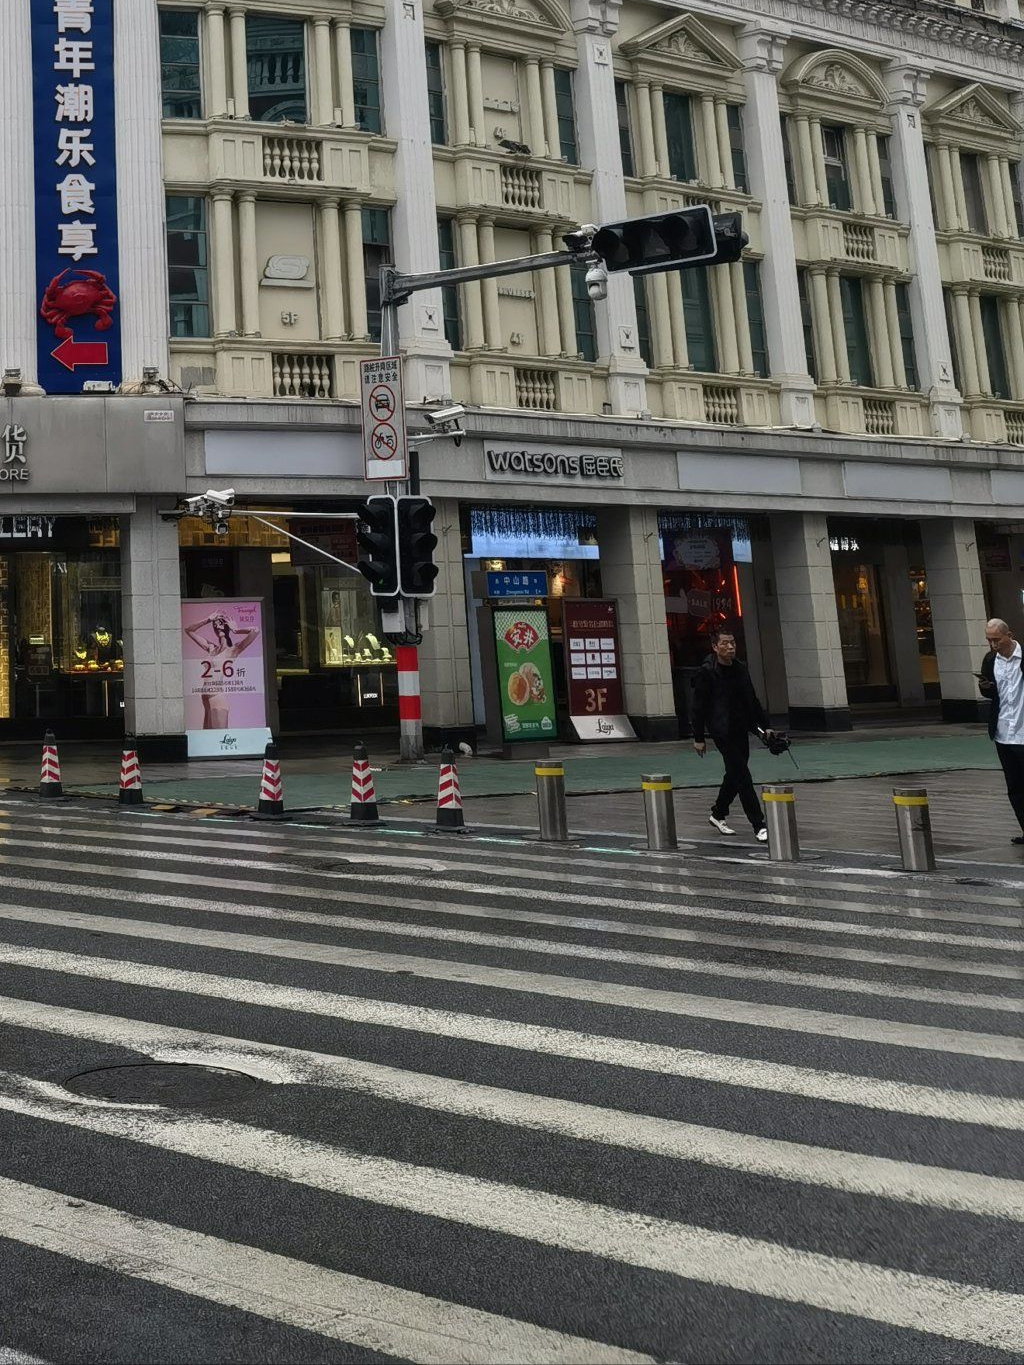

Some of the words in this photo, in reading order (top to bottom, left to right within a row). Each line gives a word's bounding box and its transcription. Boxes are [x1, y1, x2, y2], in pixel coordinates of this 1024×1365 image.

[488, 451, 579, 474] watsons
[582, 455, 624, 477] 屈臣氏
[585, 688, 608, 712] 3F
